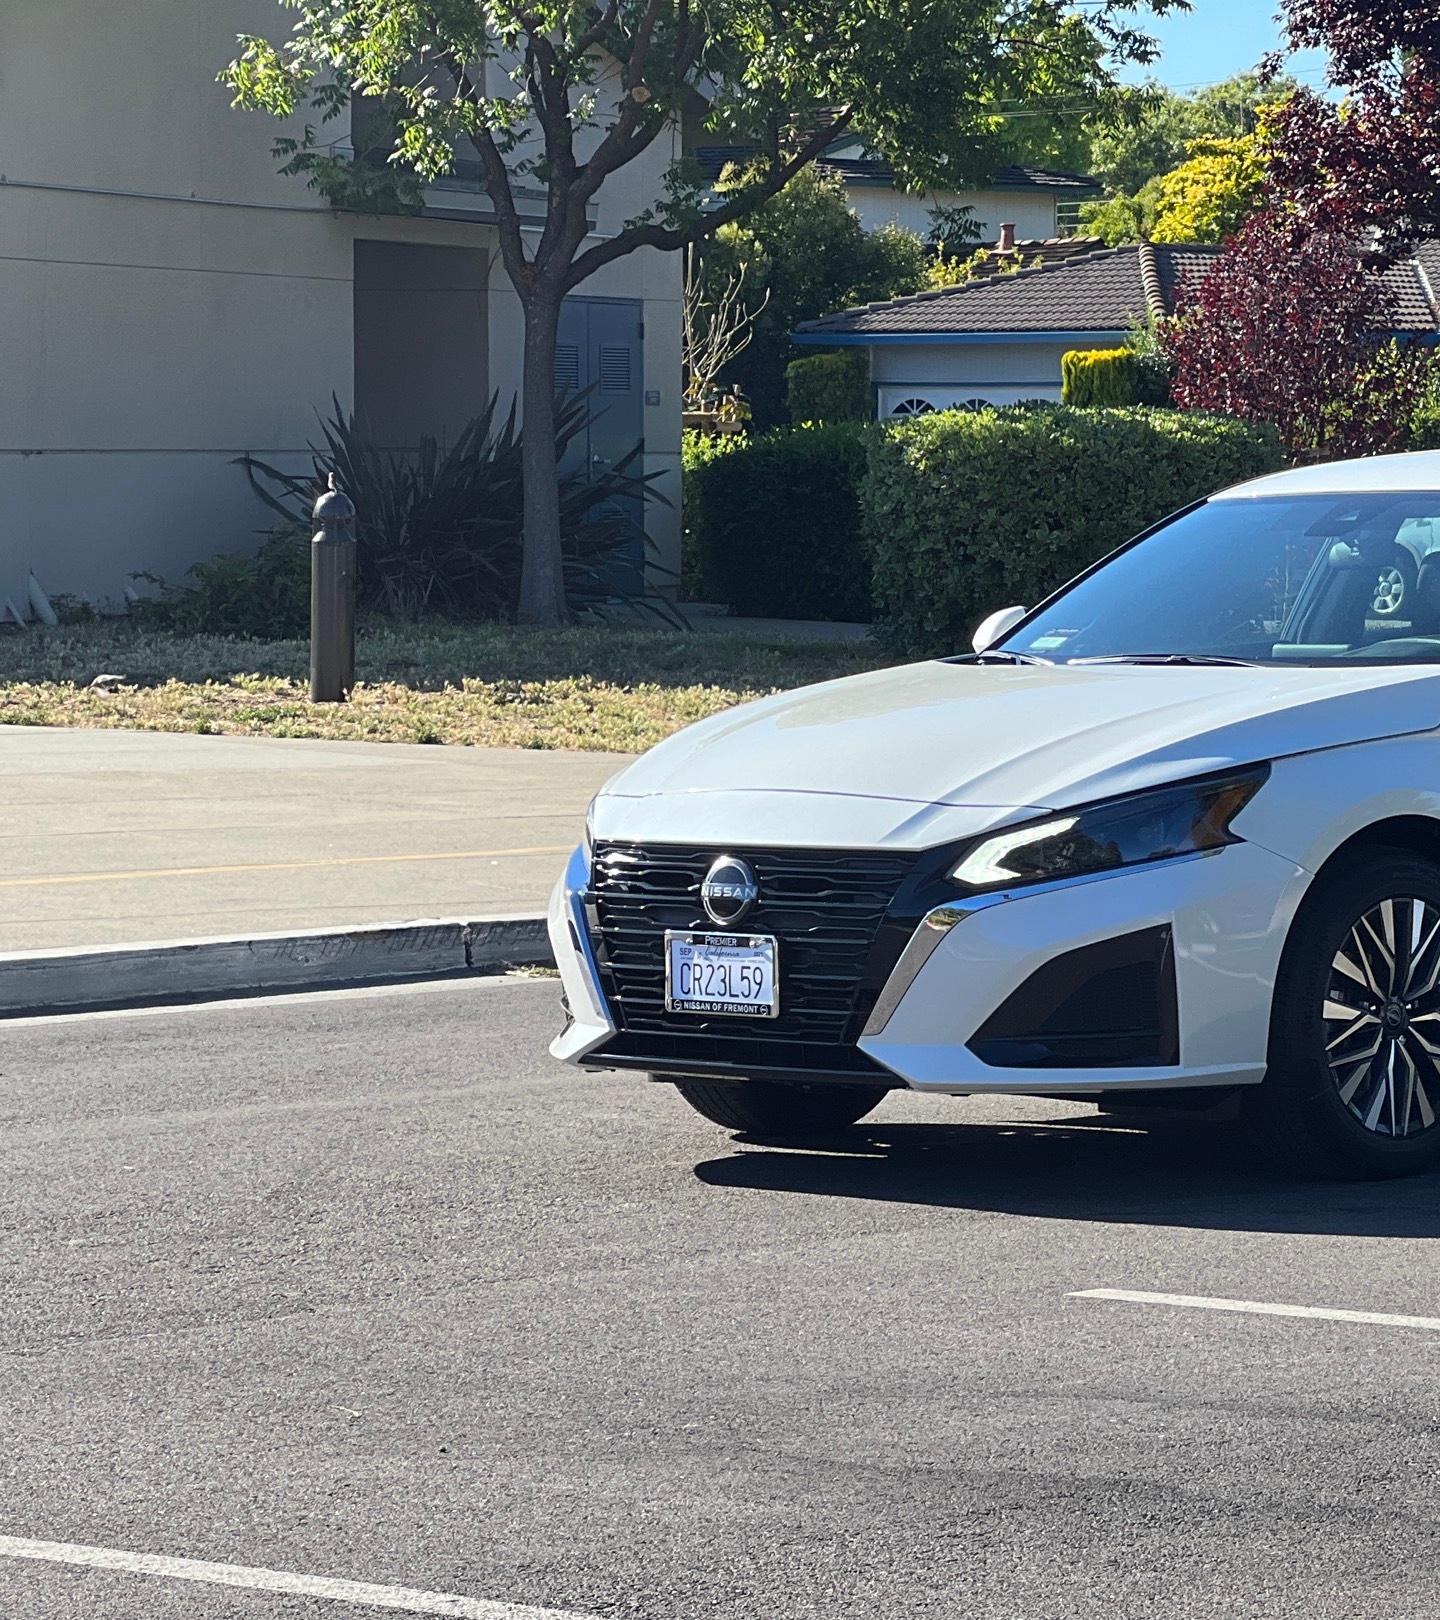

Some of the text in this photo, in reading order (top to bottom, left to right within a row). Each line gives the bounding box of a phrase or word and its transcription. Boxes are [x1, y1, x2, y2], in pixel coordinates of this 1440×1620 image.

[701, 884, 757, 898] NISSAN
[704, 935, 737, 947] PREMIER
[679, 947, 692, 956] SEP
[704, 948, 740, 960] California
[680, 962, 764, 999] CR23L59
[683, 1001, 759, 1014] NISSAN OF FREMONT
